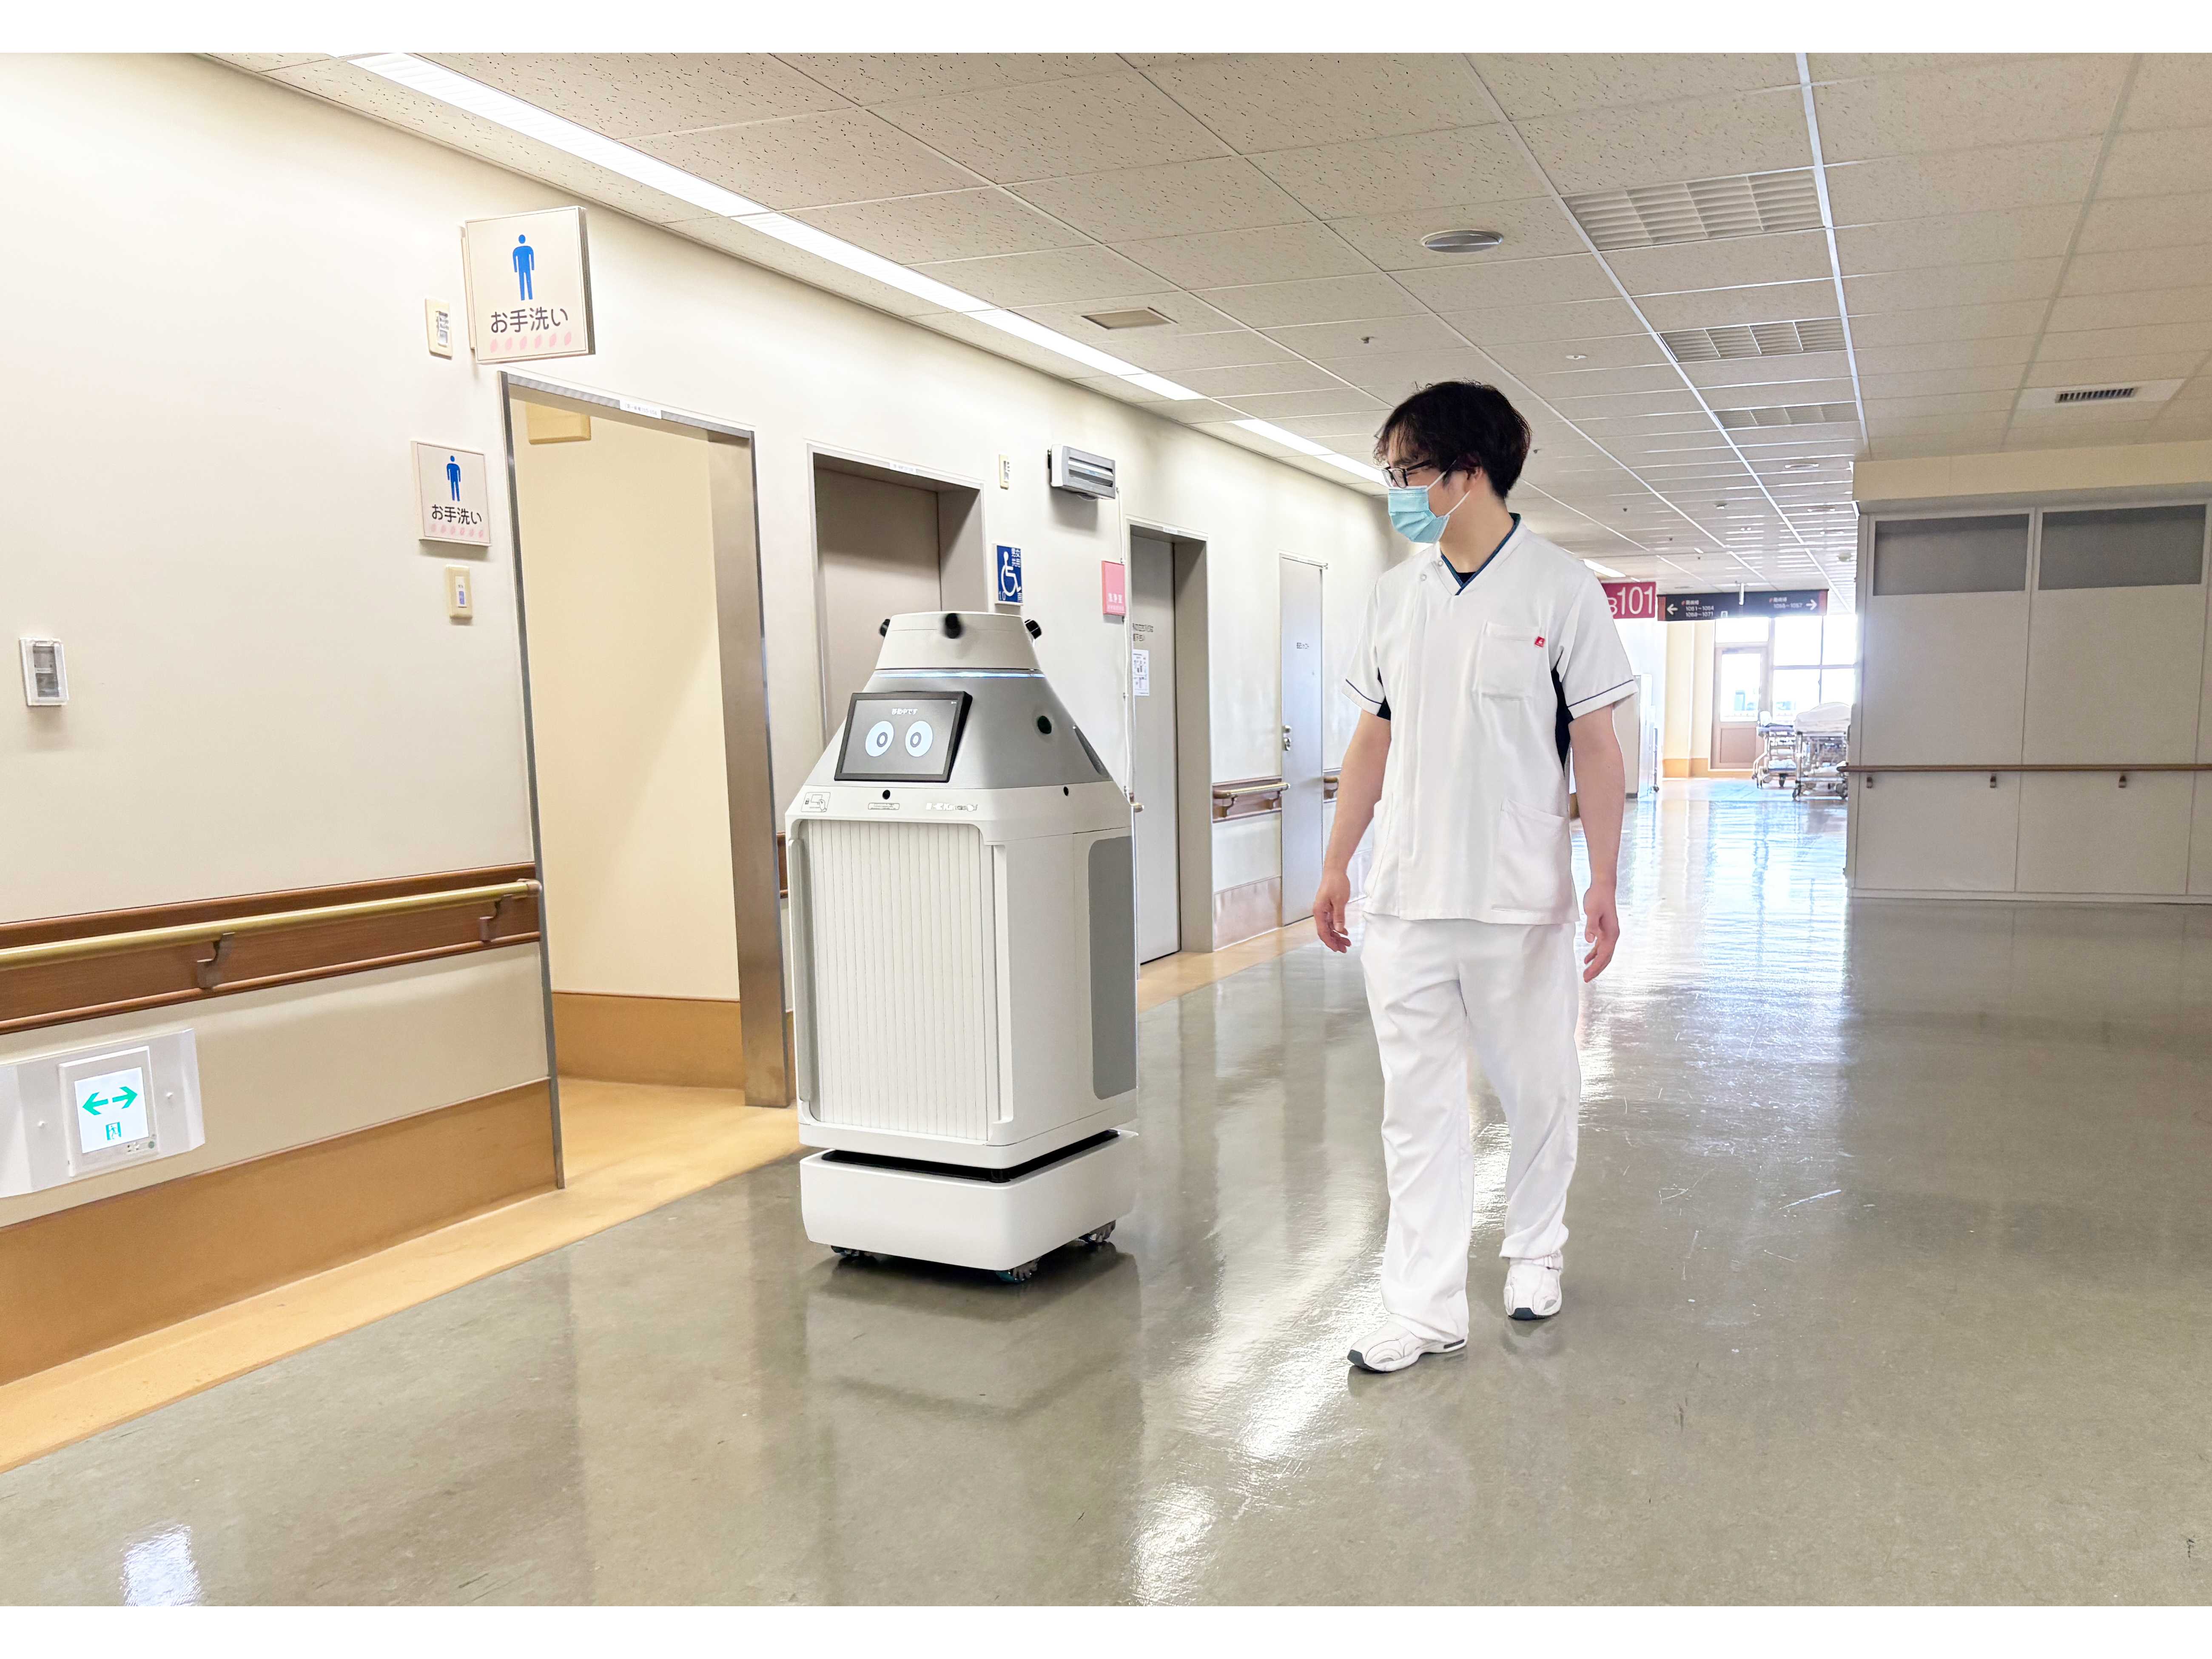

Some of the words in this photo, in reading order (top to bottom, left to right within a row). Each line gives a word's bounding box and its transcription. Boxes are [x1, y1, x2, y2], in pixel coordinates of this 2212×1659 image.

[491, 306, 568, 333] お手洗い
[432, 504, 482, 525] お手洗い
